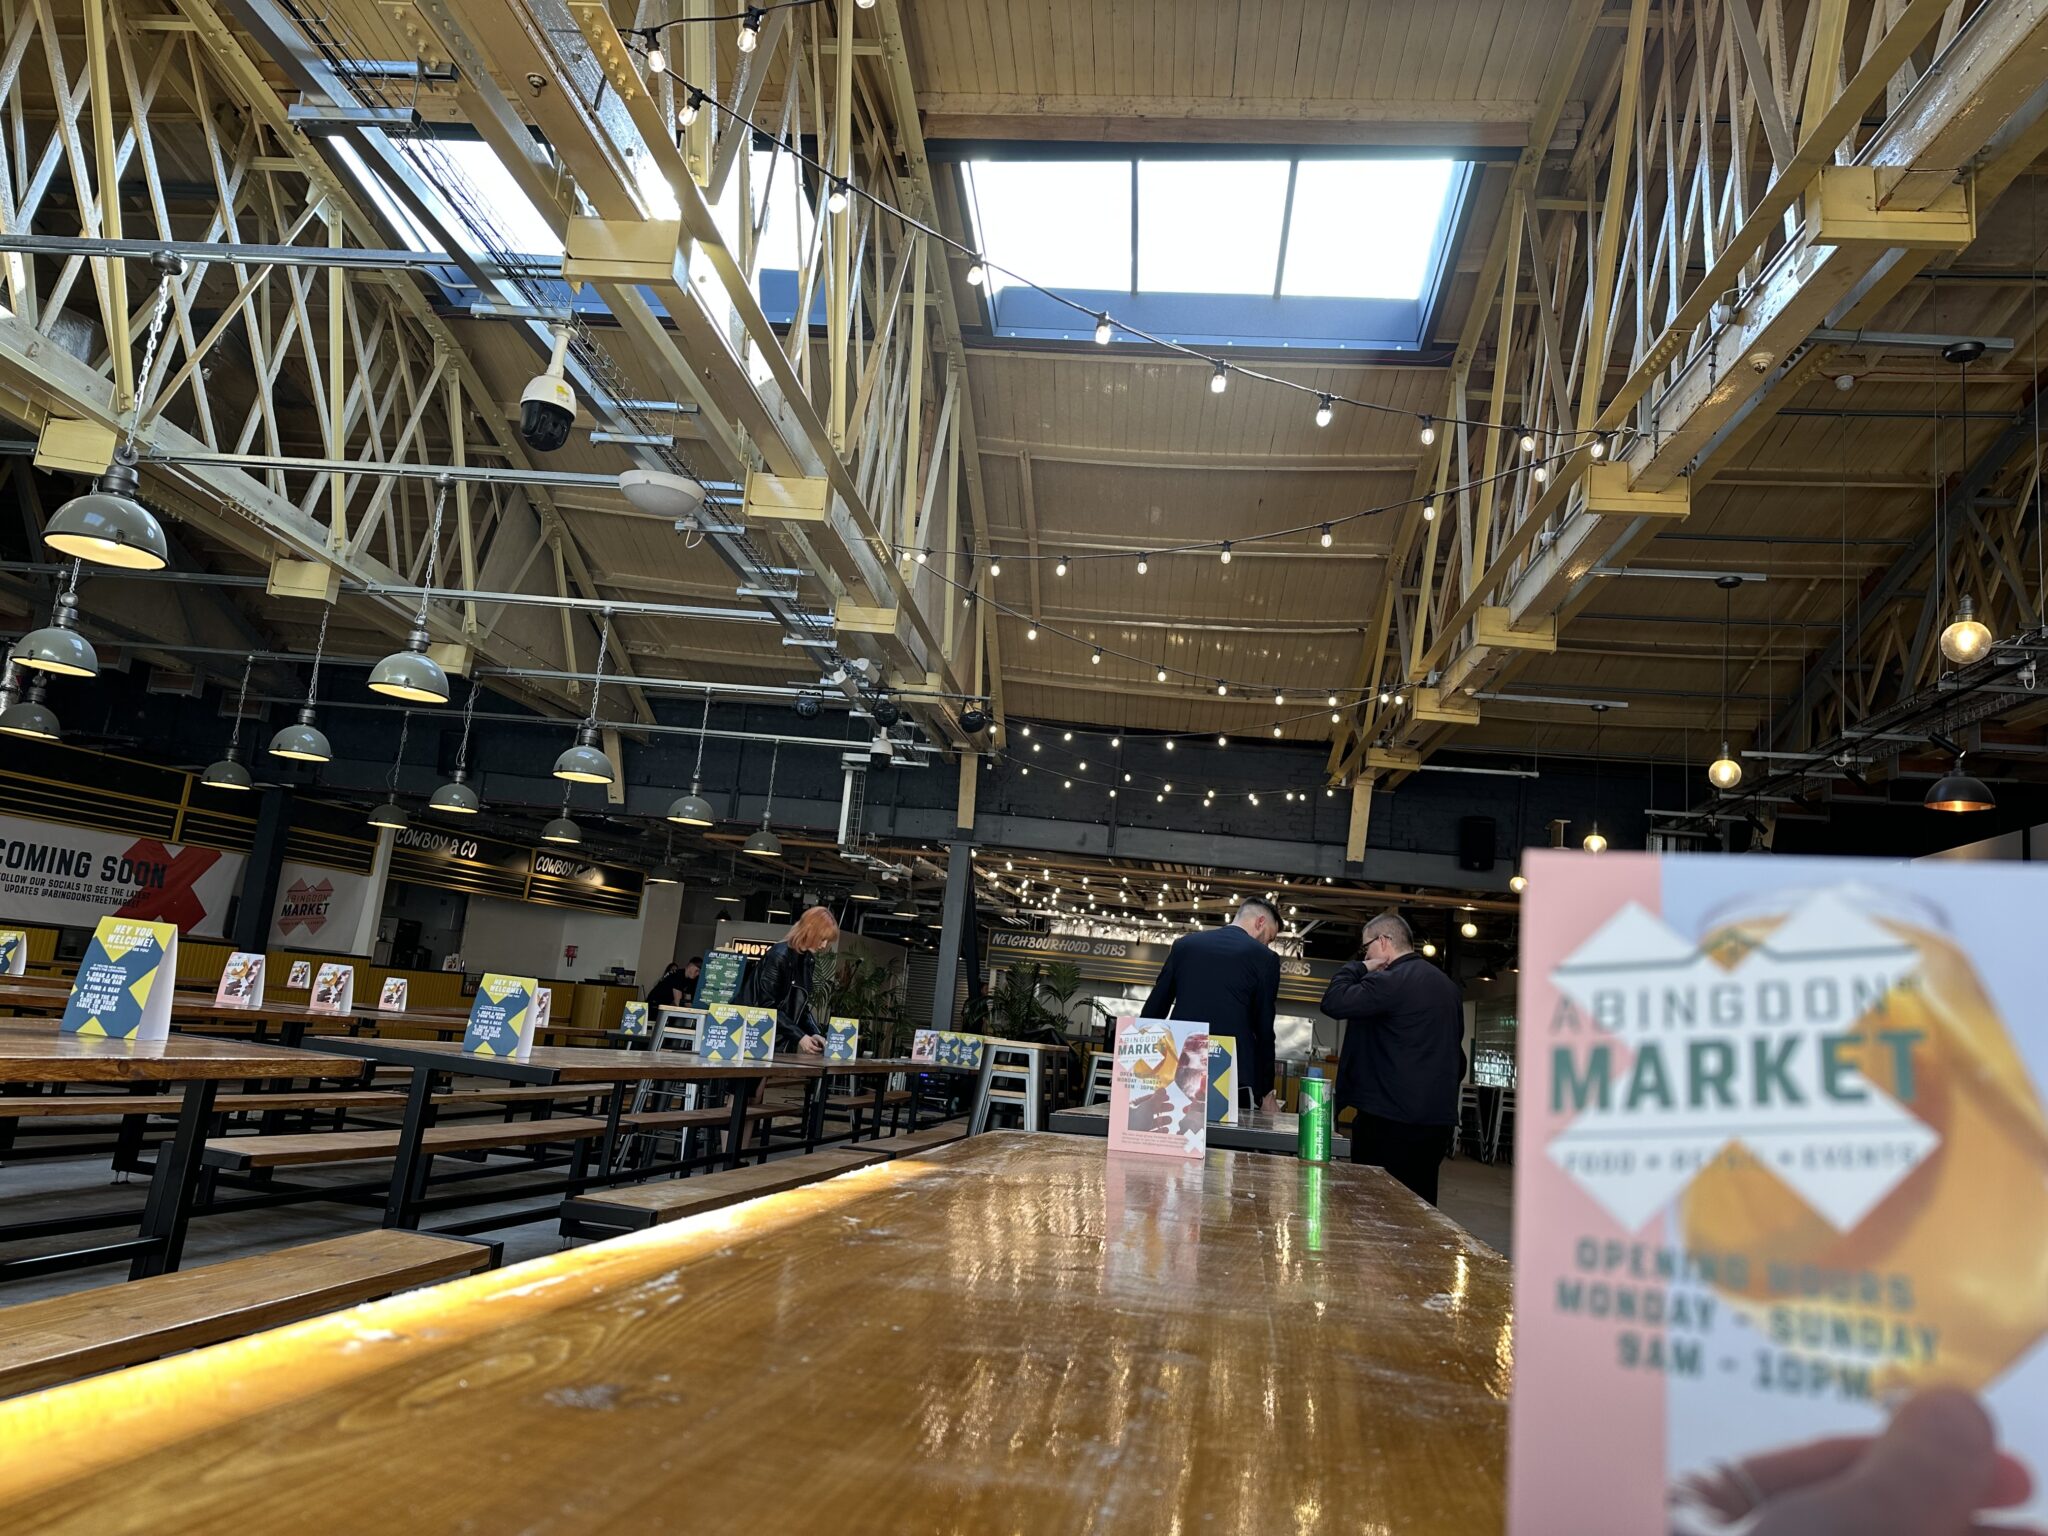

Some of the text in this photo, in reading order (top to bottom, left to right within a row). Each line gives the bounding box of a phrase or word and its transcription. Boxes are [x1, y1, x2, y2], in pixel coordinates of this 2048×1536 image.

[395, 828, 478, 859] COWBOY & CO
[101, 855, 168, 889] SOON
[536, 856, 574, 877] COWBOY
[0, 872, 27, 884] OLLOW
[29, 877, 46, 886] OUR
[48, 879, 81, 891] SOCIALS
[83, 884, 93, 892] TO
[95, 885, 109, 894] SEE
[111, 887, 125, 897] THE
[4, 884, 39, 896] UPDATES
[281, 903, 330, 917] MARKET
[107, 934, 154, 947] WELCOME!
[113, 924, 133, 934] HEY
[992, 933, 1126, 957] NEIGHBOURHOOD SUBS
[1280, 961, 1311, 976] SUBS
[1549, 973, 1890, 1033] ABINGDON
[1118, 1043, 1165, 1055] MARKET
[1551, 1030, 1924, 1114] MARKET
[1575, 1236, 1914, 1311] OPENING HOURS
[1555, 1278, 1715, 1333] MONDAY
[1769, 1307, 1939, 1361] SUNDAY
[1617, 1333, 1703, 1379] 9AM
[1755, 1349, 1872, 1400] 10PM
